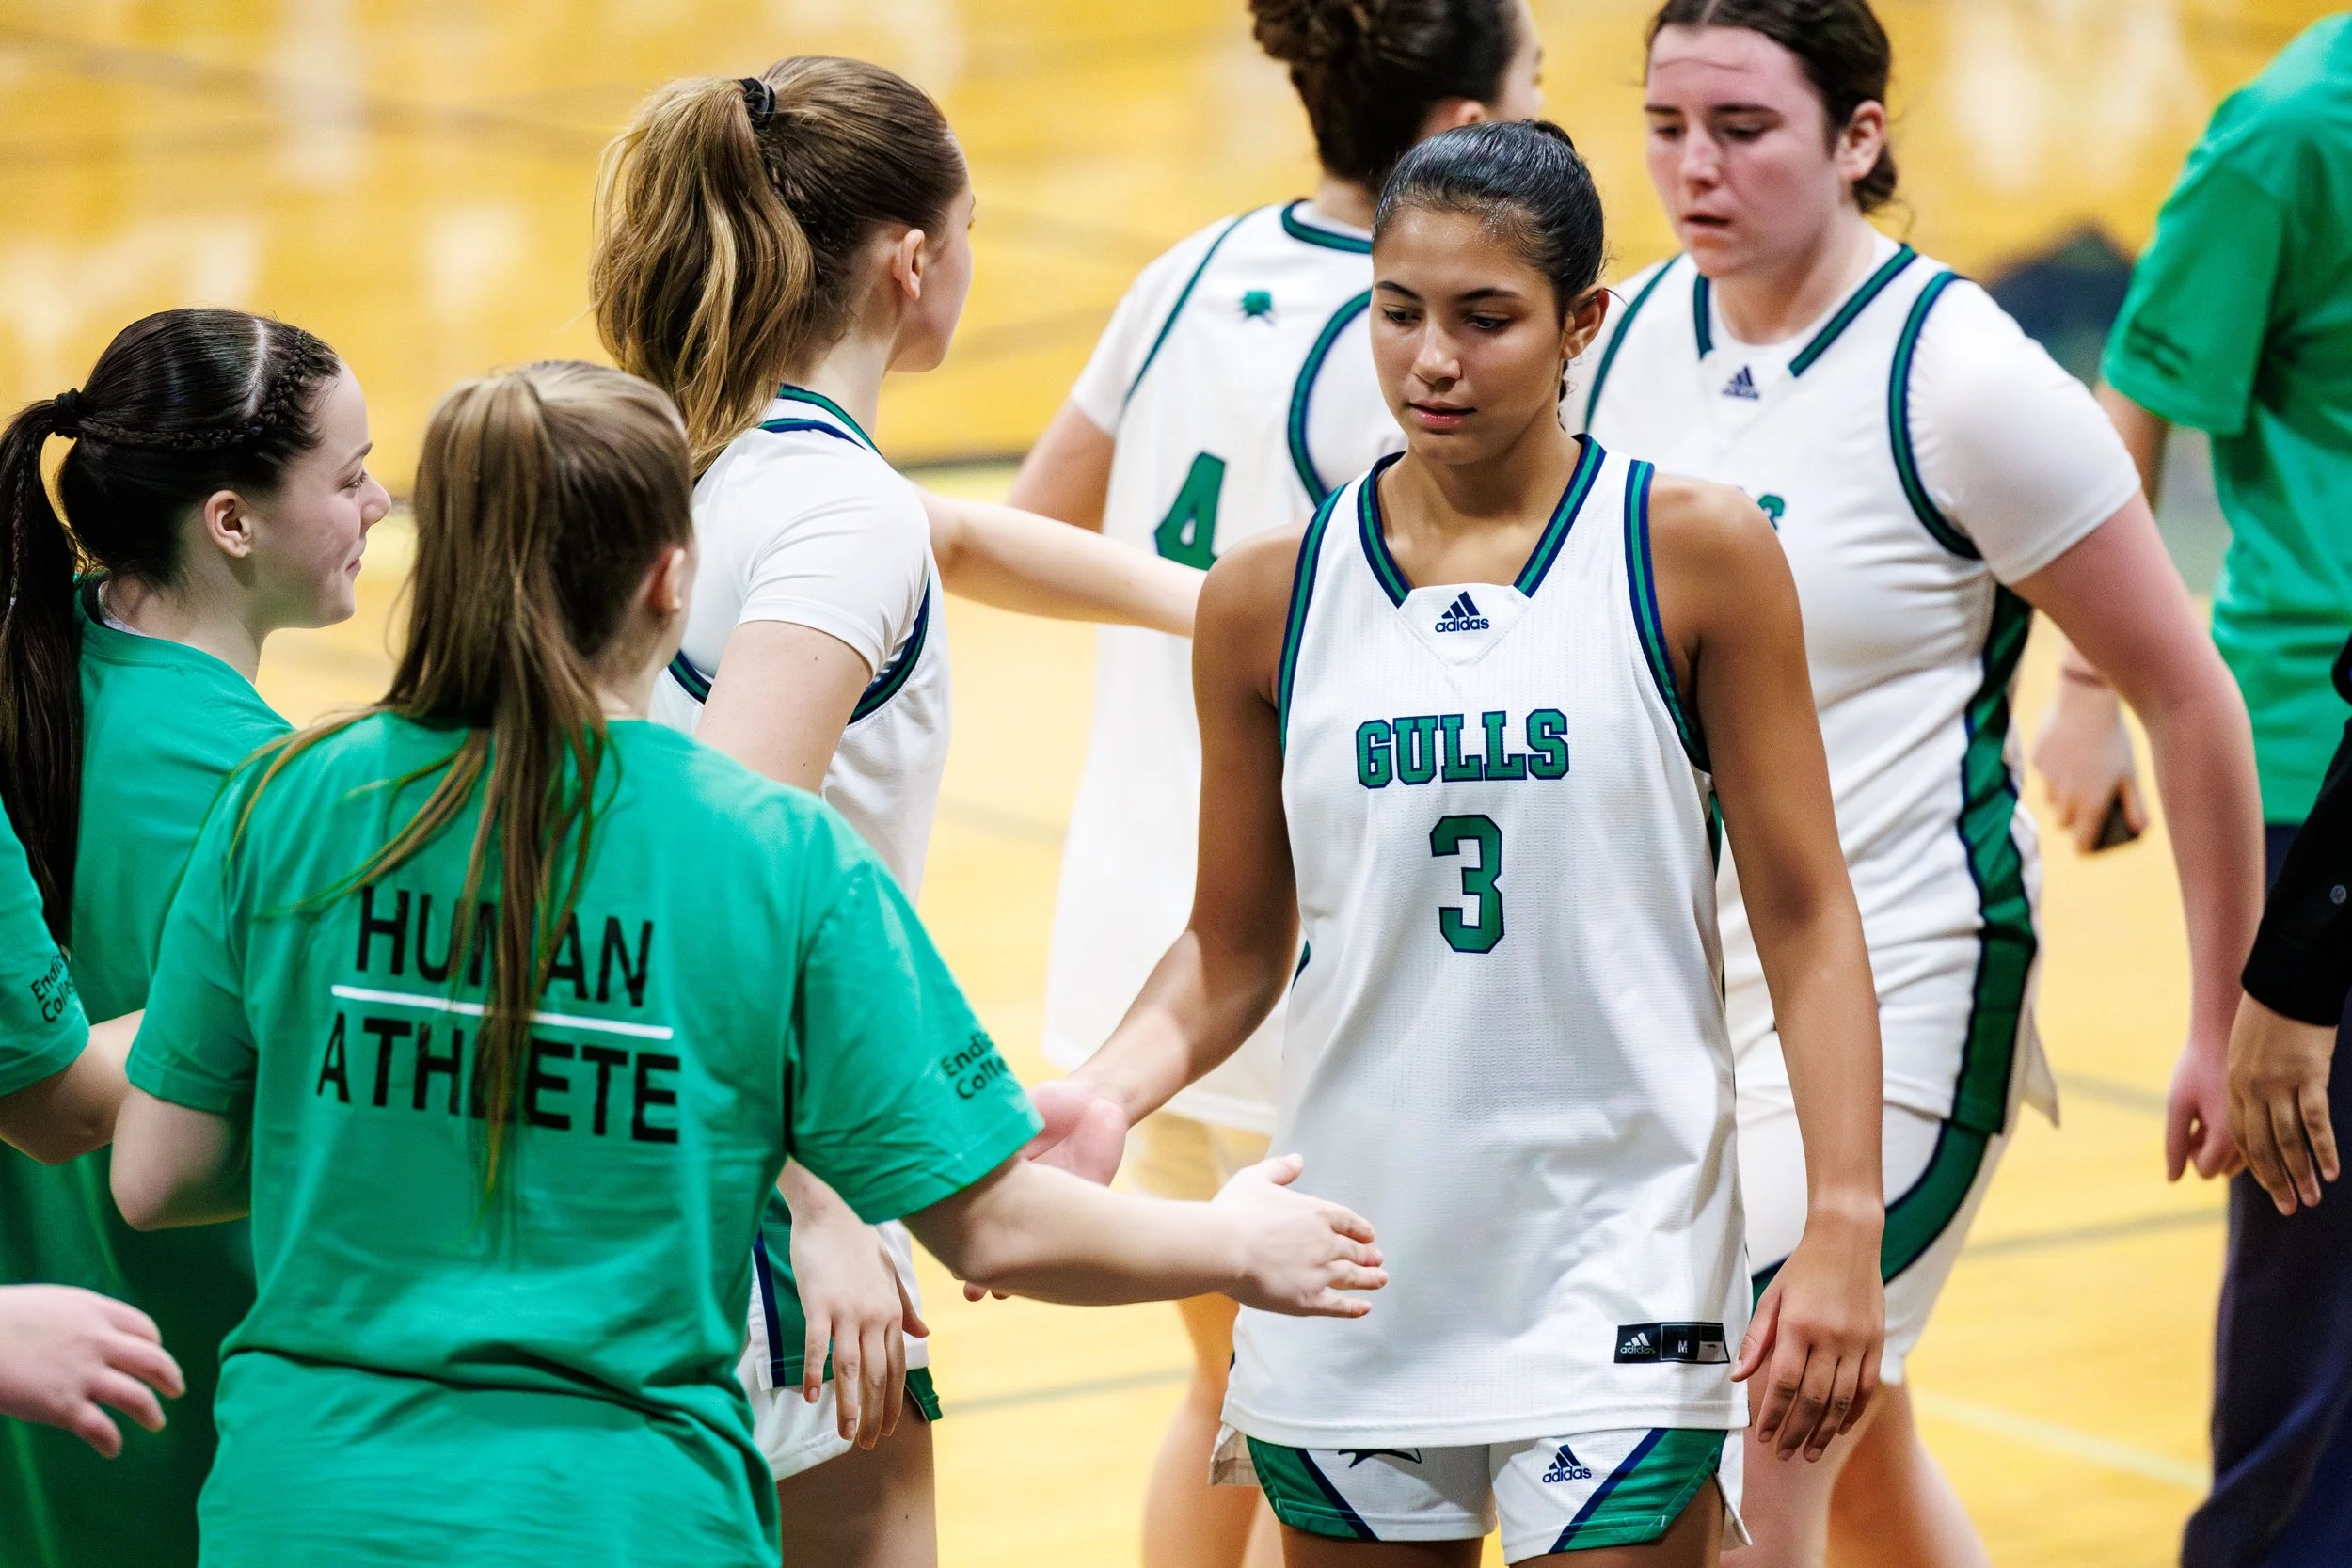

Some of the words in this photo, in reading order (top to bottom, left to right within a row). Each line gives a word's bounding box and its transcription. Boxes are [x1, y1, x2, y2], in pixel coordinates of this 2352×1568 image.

[1153, 450, 1226, 572] 4
[1435, 616, 1490, 633] adidas
[1356, 708, 1570, 789] GULLS
[1429, 814, 1505, 955] 3
[1620, 1344, 1656, 1354] adidas
[1677, 1339, 1688, 1354] M
[1542, 1466, 1592, 1483] adidas
